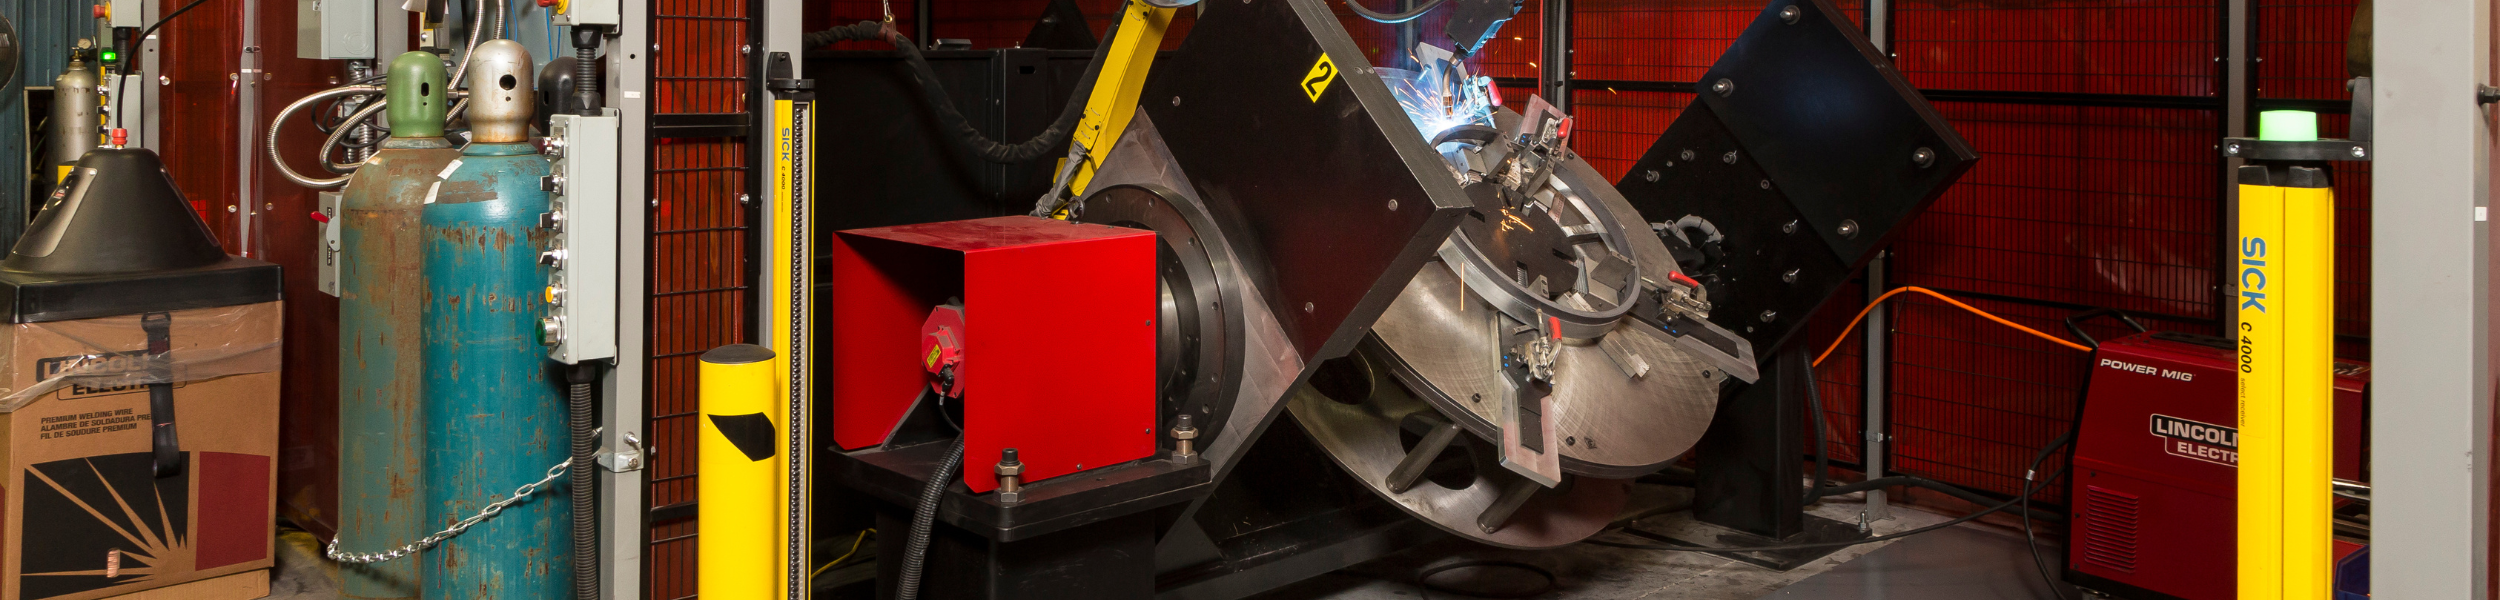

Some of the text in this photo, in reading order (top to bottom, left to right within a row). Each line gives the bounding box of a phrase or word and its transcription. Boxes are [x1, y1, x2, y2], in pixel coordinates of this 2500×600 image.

[1305, 61, 1332, 97] 2
[781, 127, 790, 161] SICK
[2241, 236, 2266, 314] SICK
[2241, 321, 2252, 332] C
[2240, 335, 2253, 374] 4000
[2100, 358, 2193, 382] POWER MIG
[41, 408, 133, 424] PREMIUM WELDING WIRE
[41, 413, 152, 432] ALAMBRE DE SOLDADURA PRE
[66, 427, 100, 437] SOUDURE
[102, 423, 137, 433] PREMIUM
